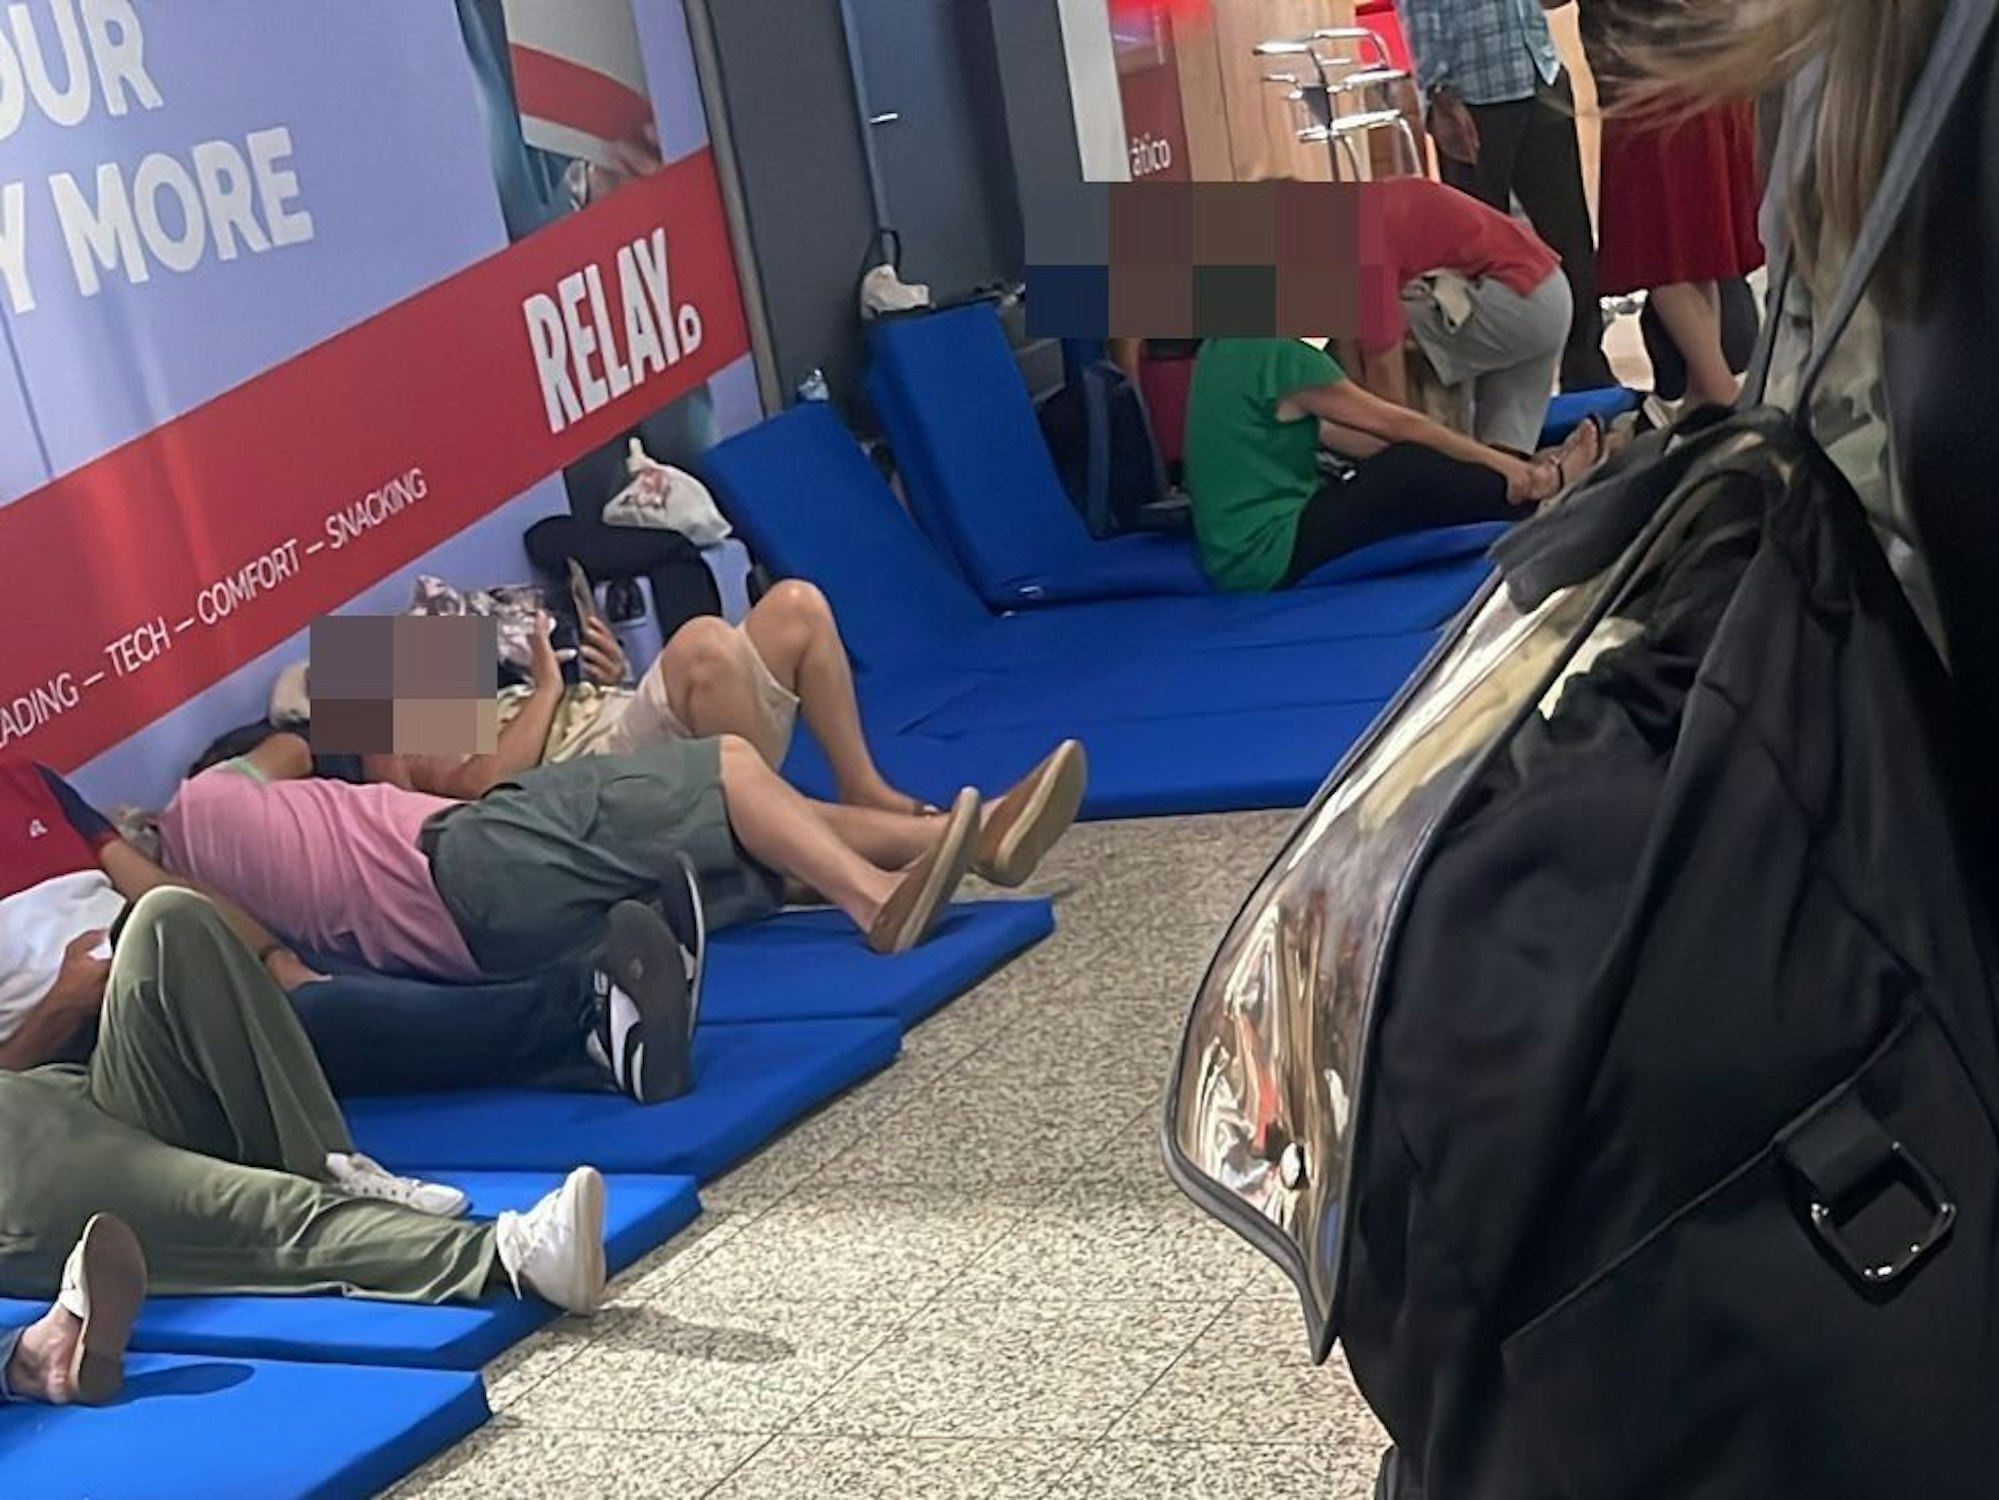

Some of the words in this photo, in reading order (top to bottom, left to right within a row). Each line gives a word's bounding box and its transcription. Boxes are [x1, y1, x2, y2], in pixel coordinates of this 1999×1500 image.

[48, 126, 314, 296] MORE
[104, 617, 171, 677] TECH
[197, 538, 299, 625] COMFORT
[325, 467, 427, 549] SNACKING
